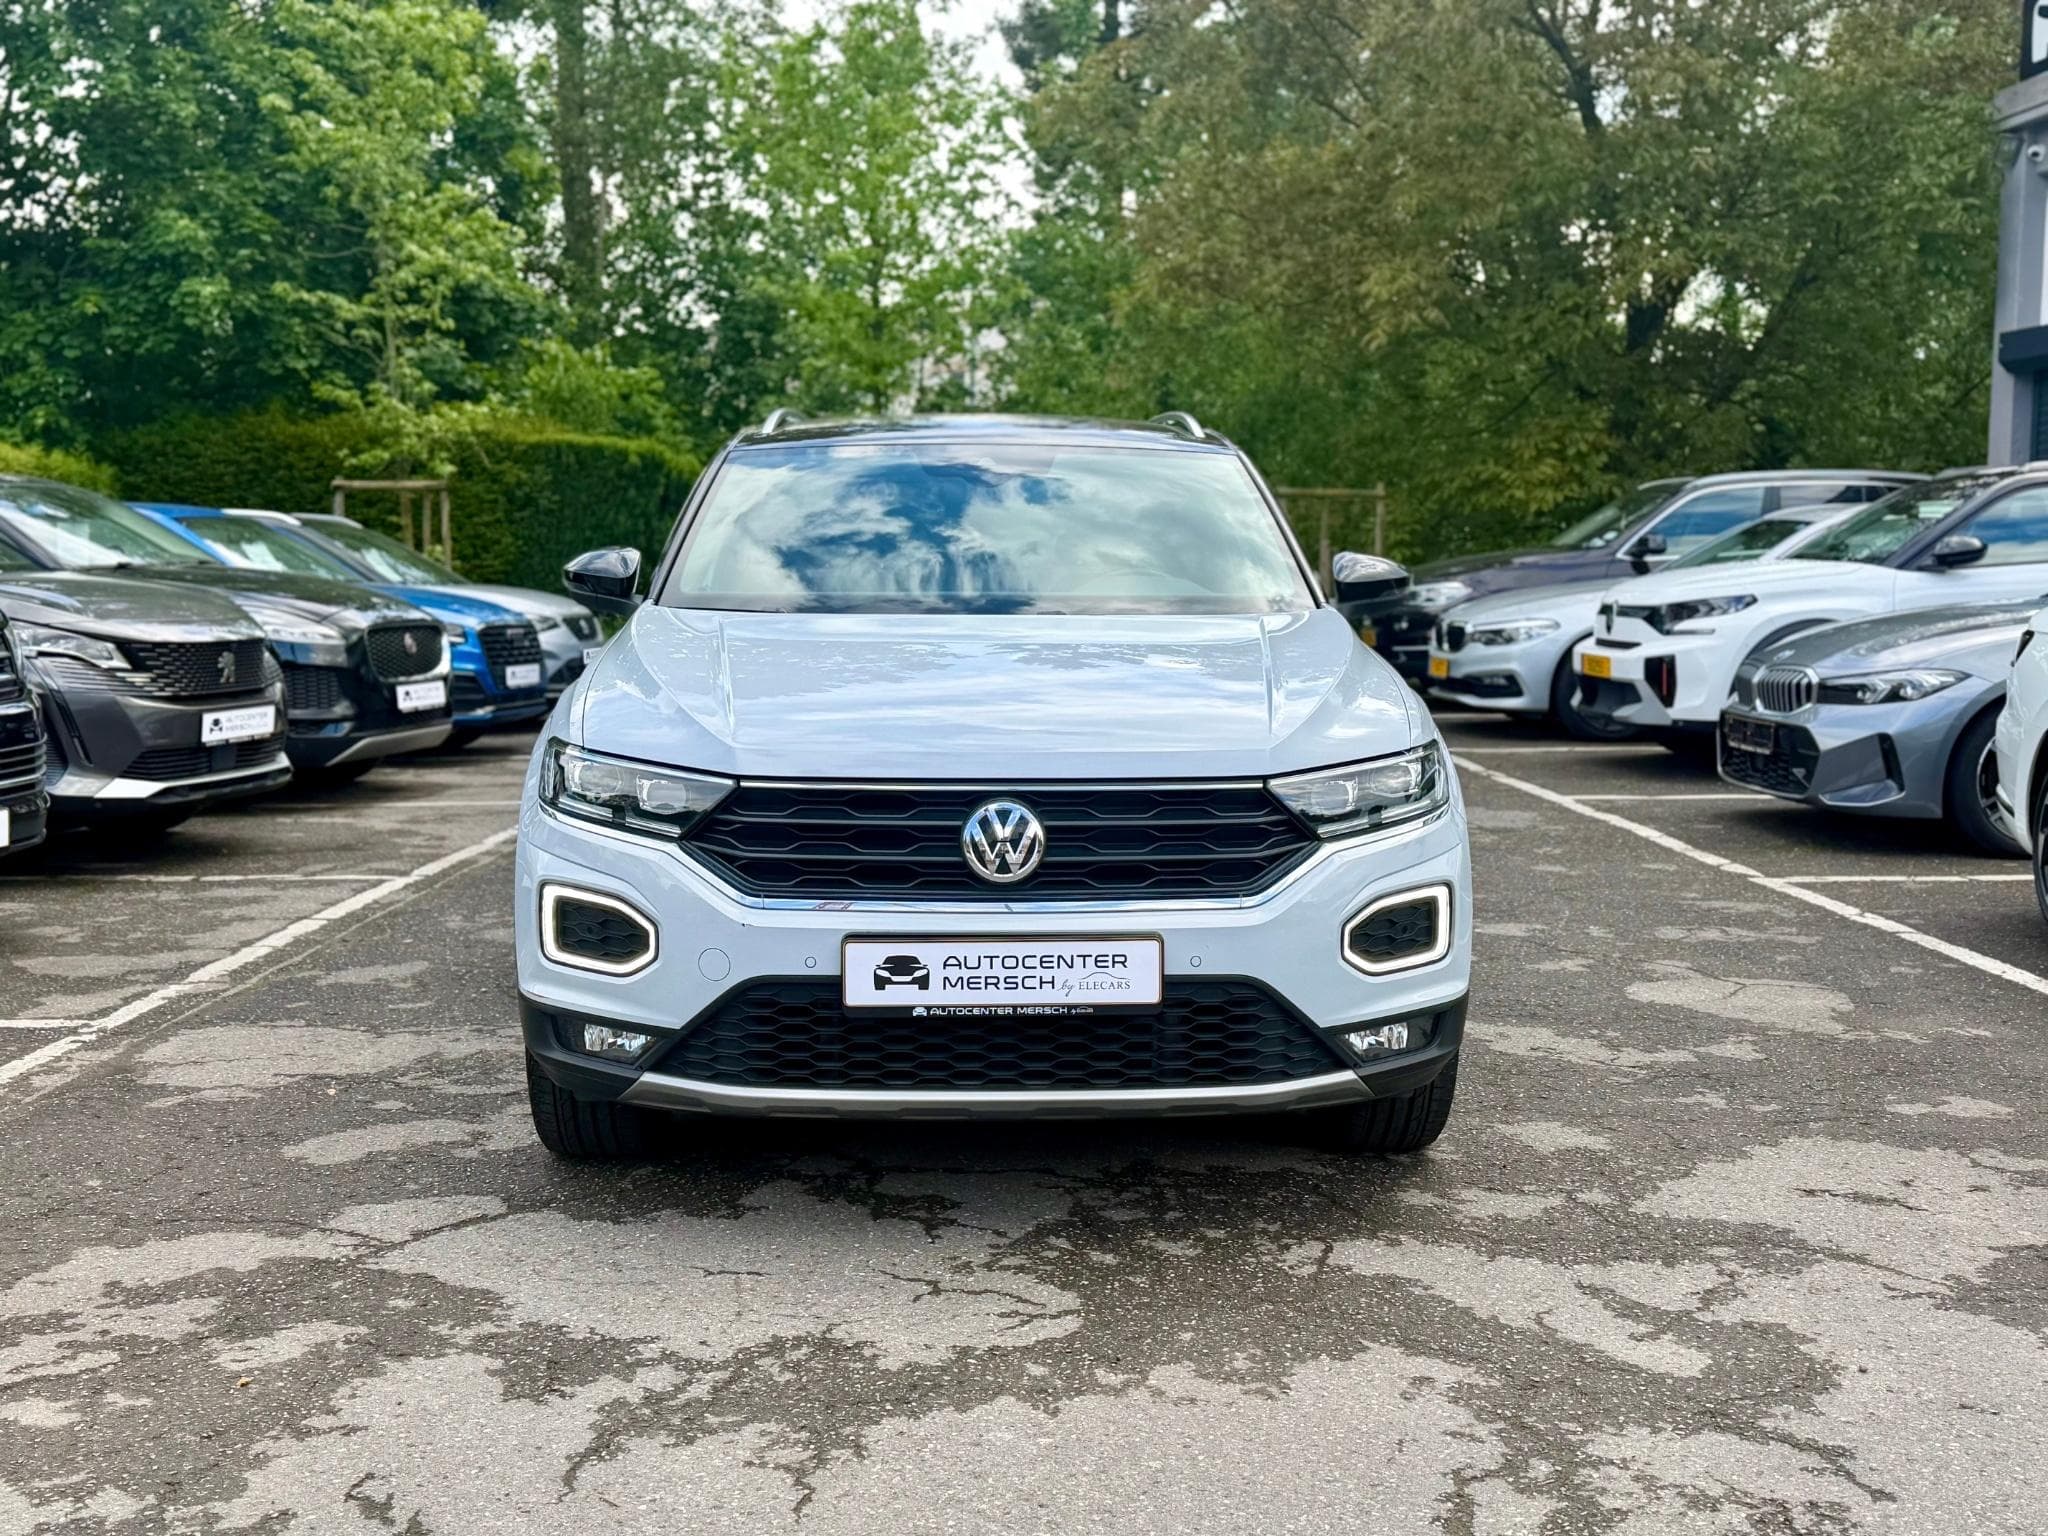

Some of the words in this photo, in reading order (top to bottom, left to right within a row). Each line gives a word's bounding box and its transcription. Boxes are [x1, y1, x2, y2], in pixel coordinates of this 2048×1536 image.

[942, 954, 1129, 970] AUTOCENTER
[942, 975, 1056, 991] MERSCH
[1057, 979, 1076, 998] by
[1078, 981, 1132, 991] ELECARS
[930, 1007, 1013, 1016] AUTOCENTER
[1016, 1006, 1068, 1015] MERSCH
